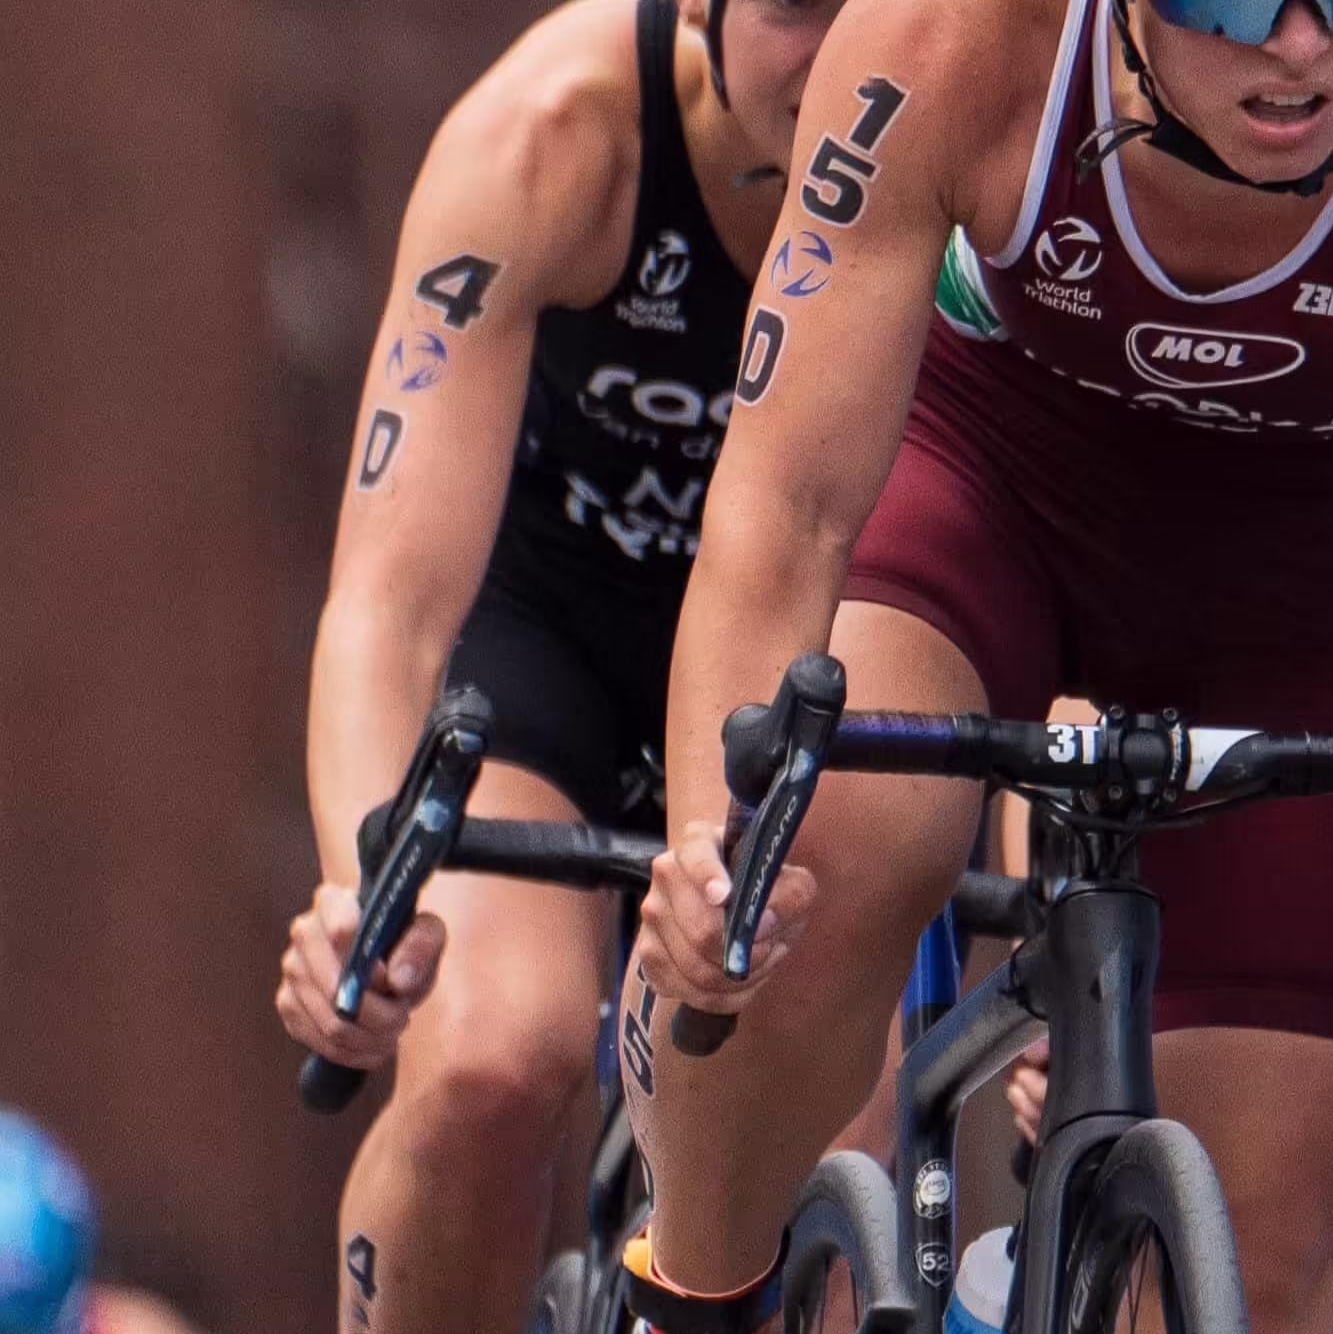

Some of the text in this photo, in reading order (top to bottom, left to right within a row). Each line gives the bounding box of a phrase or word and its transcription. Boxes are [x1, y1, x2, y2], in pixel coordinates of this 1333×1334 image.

[415, 251, 503, 332] 4
[1024, 284, 1102, 320] Triathlon
[1034, 278, 1091, 302] World
[736, 304, 788, 407] D
[1151, 335, 1244, 368] MOL
[1047, 723, 1100, 764] 3T
[921, 1251, 951, 1271] 52
